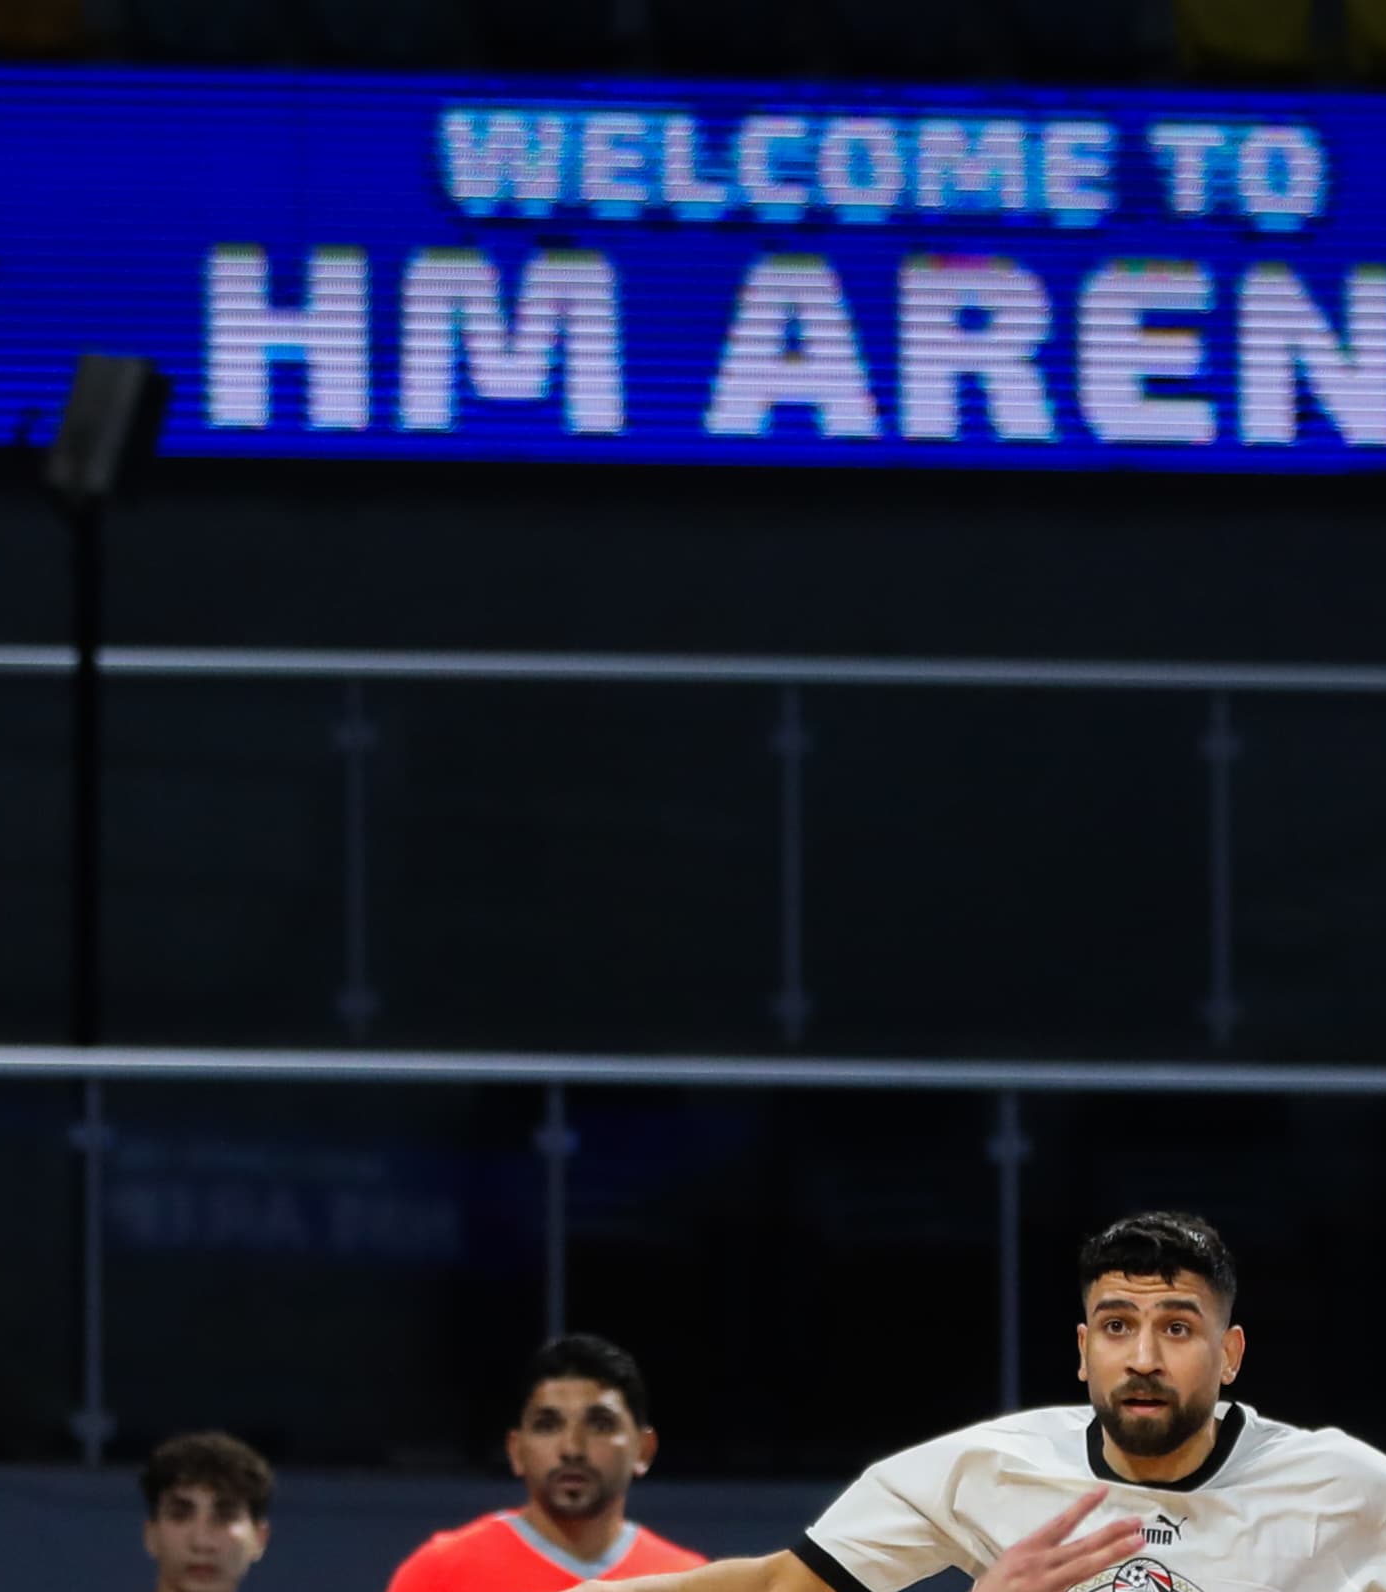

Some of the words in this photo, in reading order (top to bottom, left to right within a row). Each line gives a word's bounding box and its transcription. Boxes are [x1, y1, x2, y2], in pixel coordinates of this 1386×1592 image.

[440, 110, 1114, 211] WELCOME
[1146, 121, 1326, 218] TO
[206, 240, 626, 436] HM
